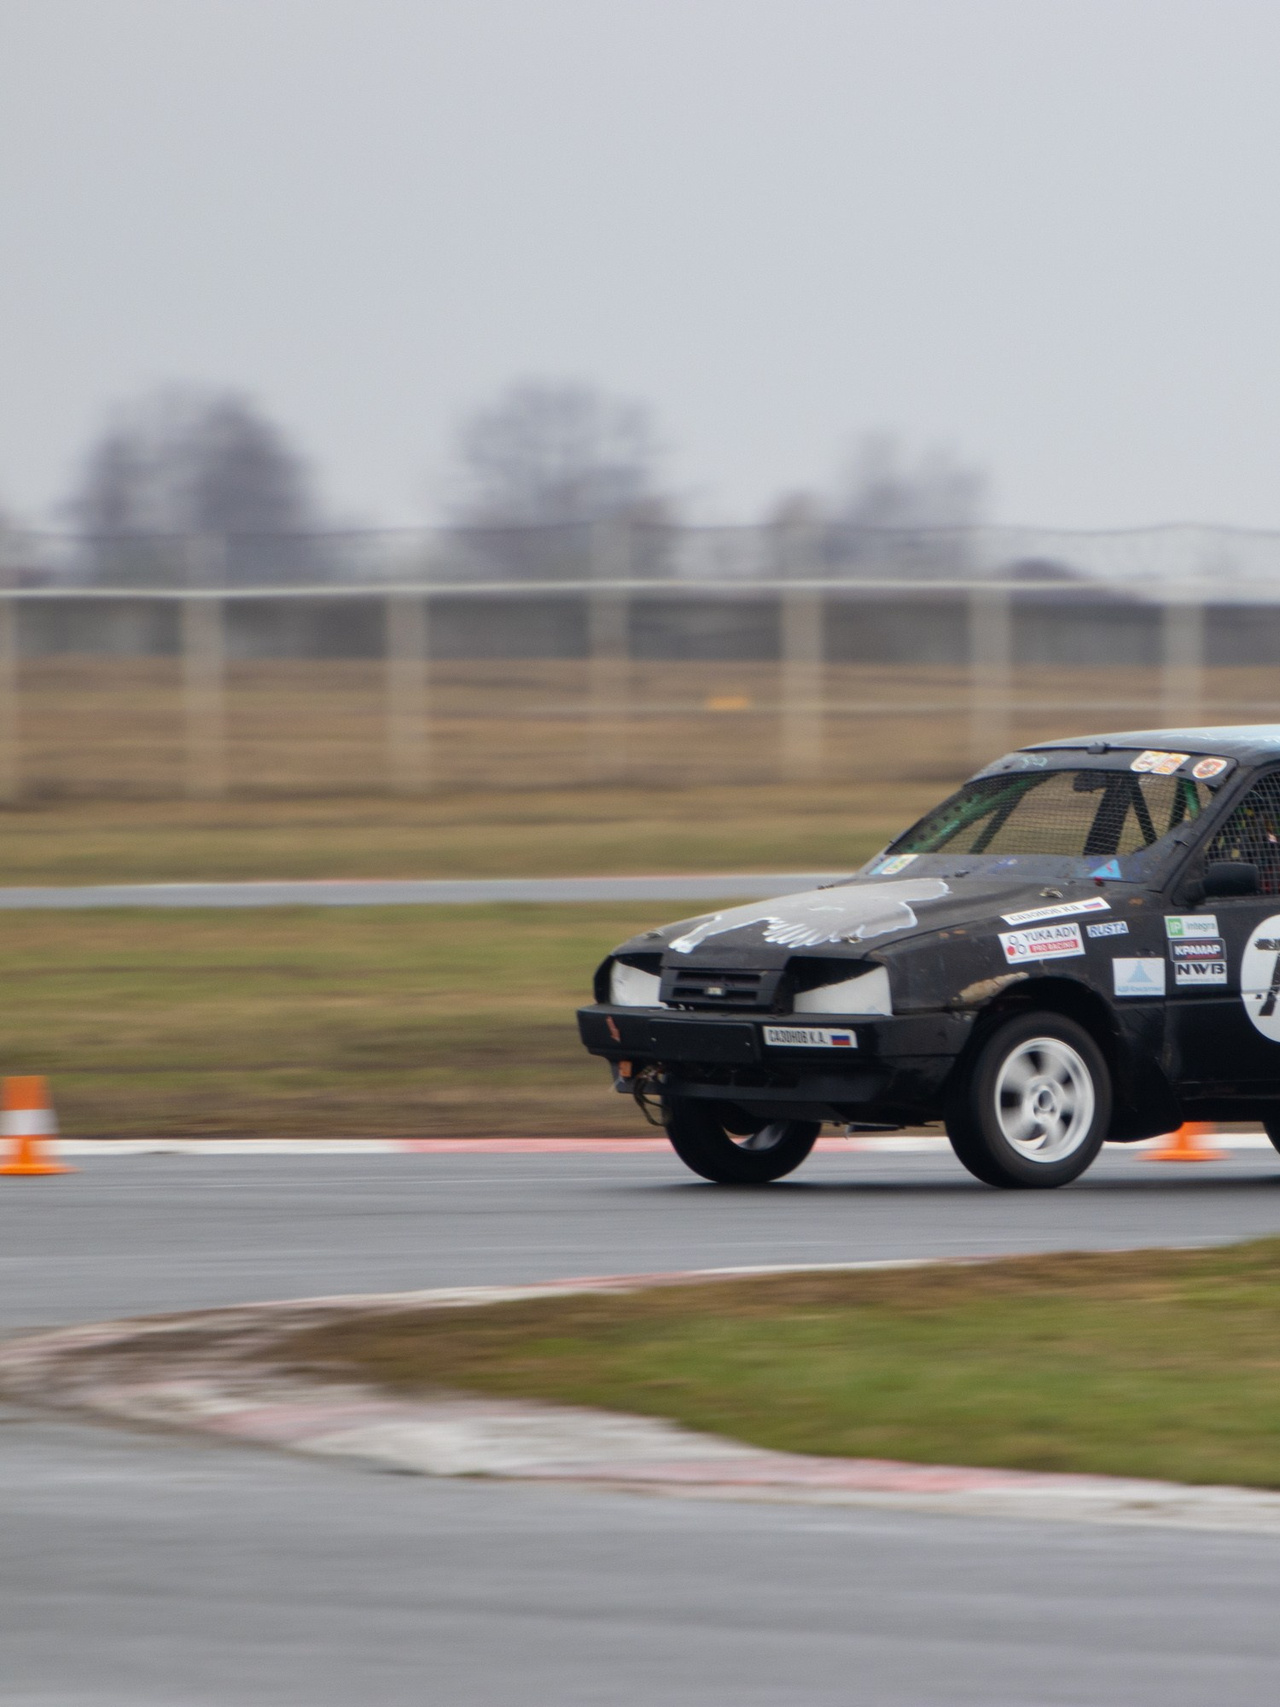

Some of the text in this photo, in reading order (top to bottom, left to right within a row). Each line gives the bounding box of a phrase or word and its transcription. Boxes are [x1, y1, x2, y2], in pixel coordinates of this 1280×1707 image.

[1022, 925, 1078, 942] YUKA ADV
[1090, 923, 1127, 937] RUSTA
[1177, 963, 1225, 976] NWB
[768, 1029, 808, 1044] САЗОНОВ
